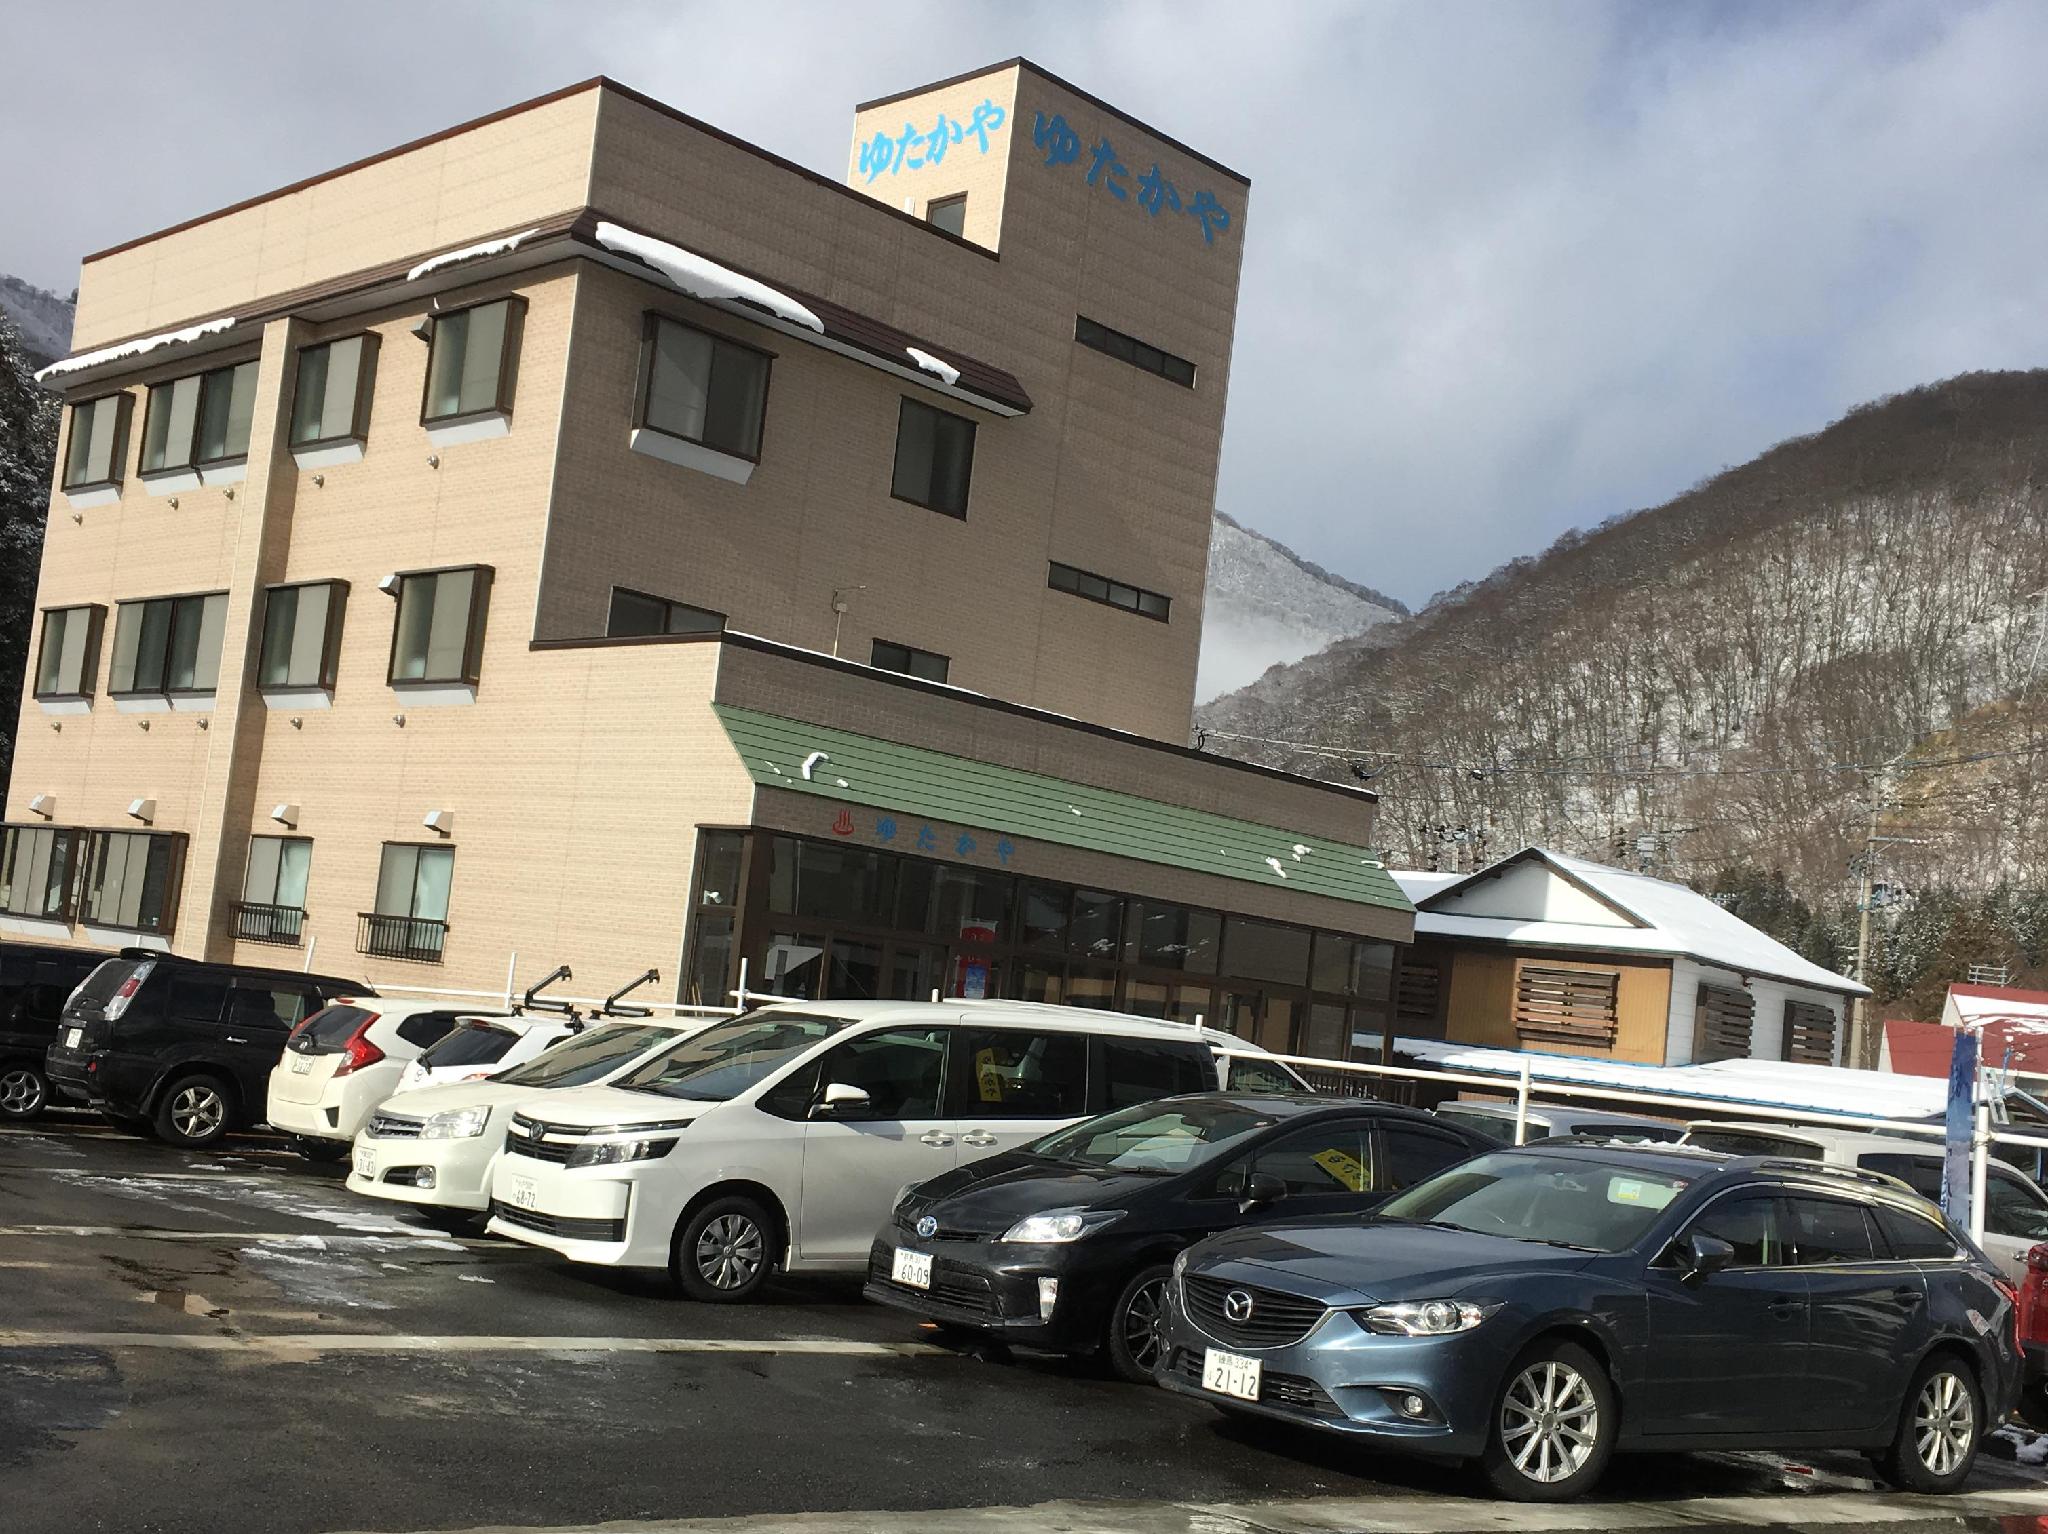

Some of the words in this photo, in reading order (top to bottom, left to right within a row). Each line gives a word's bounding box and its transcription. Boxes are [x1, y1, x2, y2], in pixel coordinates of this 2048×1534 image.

[859, 98, 1006, 185] ゆたかや
[1032, 110, 1231, 246] ゆたかや
[875, 815, 1015, 865] ゆたかや
[901, 1264, 929, 1285] 60-09
[1214, 1367, 1257, 1397] 21-12
